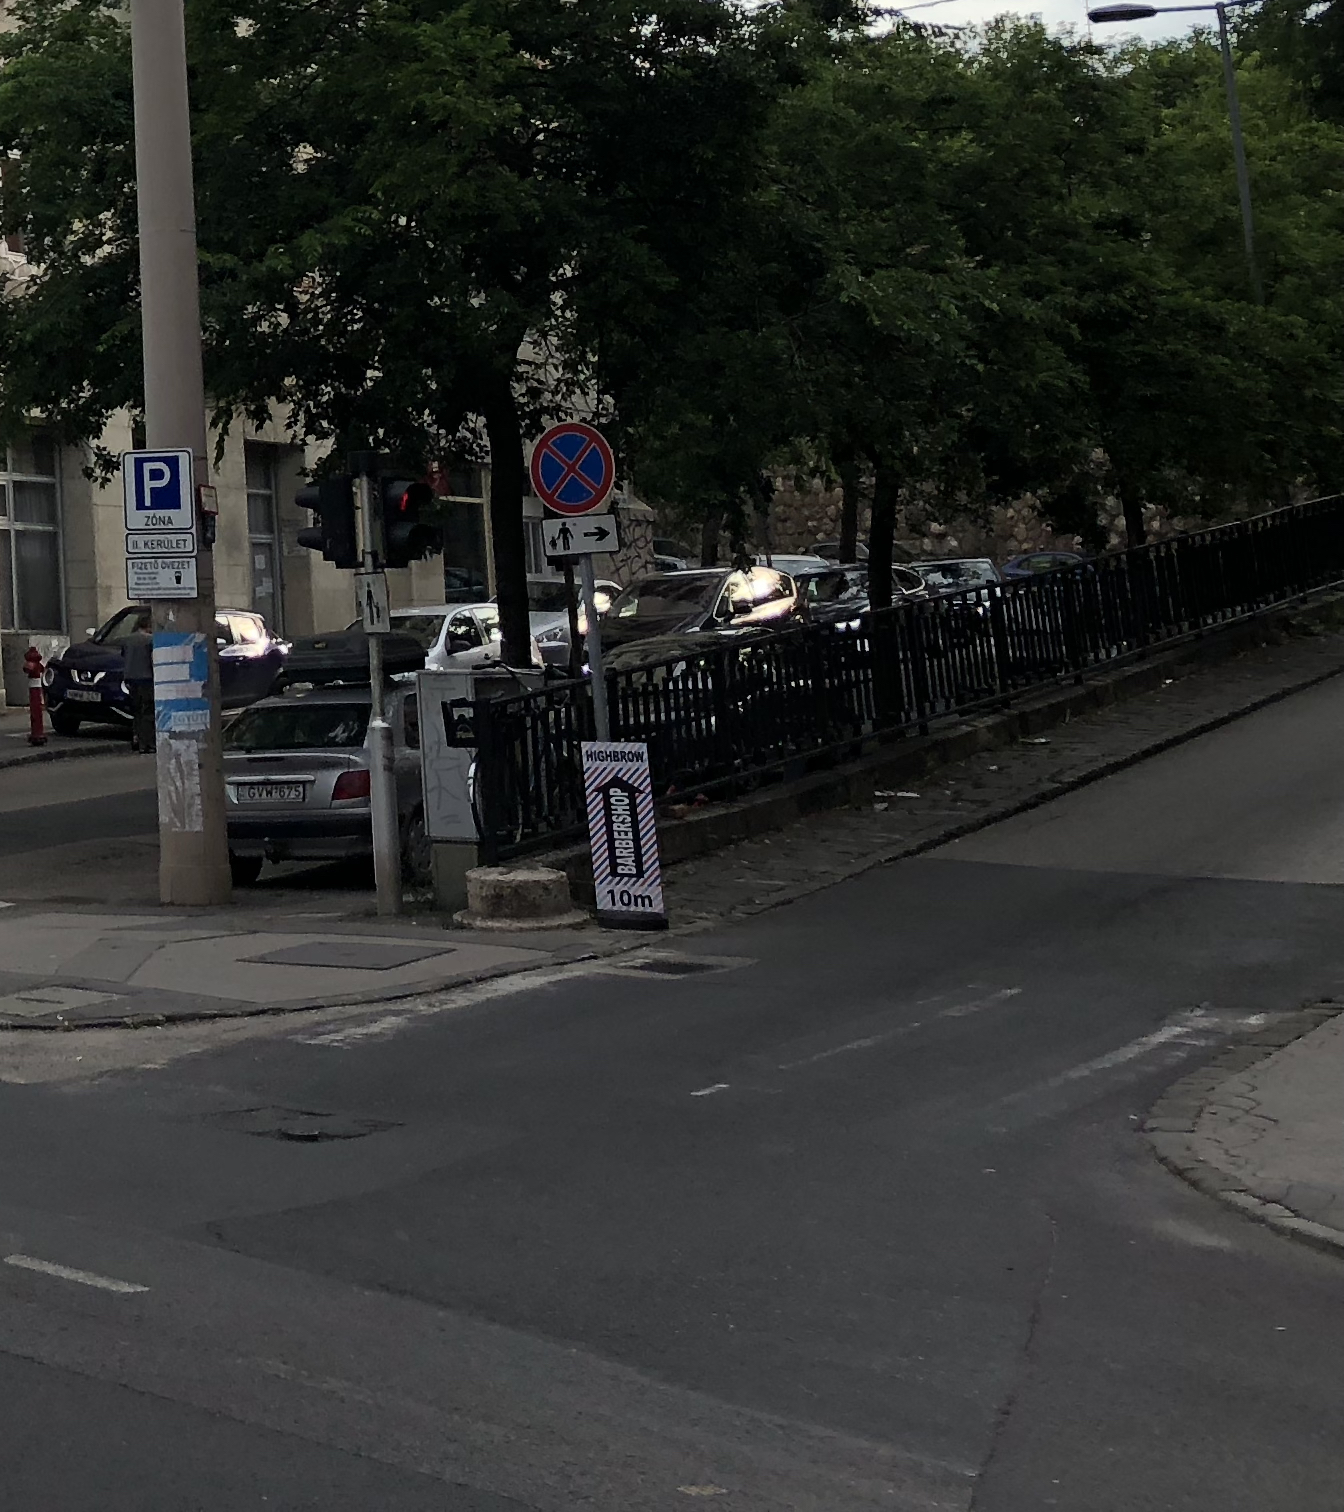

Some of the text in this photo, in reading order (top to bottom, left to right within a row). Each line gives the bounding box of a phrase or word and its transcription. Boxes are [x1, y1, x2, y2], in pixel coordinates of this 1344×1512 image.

[143, 461, 171, 507] P
[144, 512, 173, 526] ZÓNA
[143, 538, 188, 550] KERÜLET
[585, 749, 644, 763] HIGHBROW
[609, 787, 637, 875] BARBERSHOP
[606, 889, 653, 908] 10m
